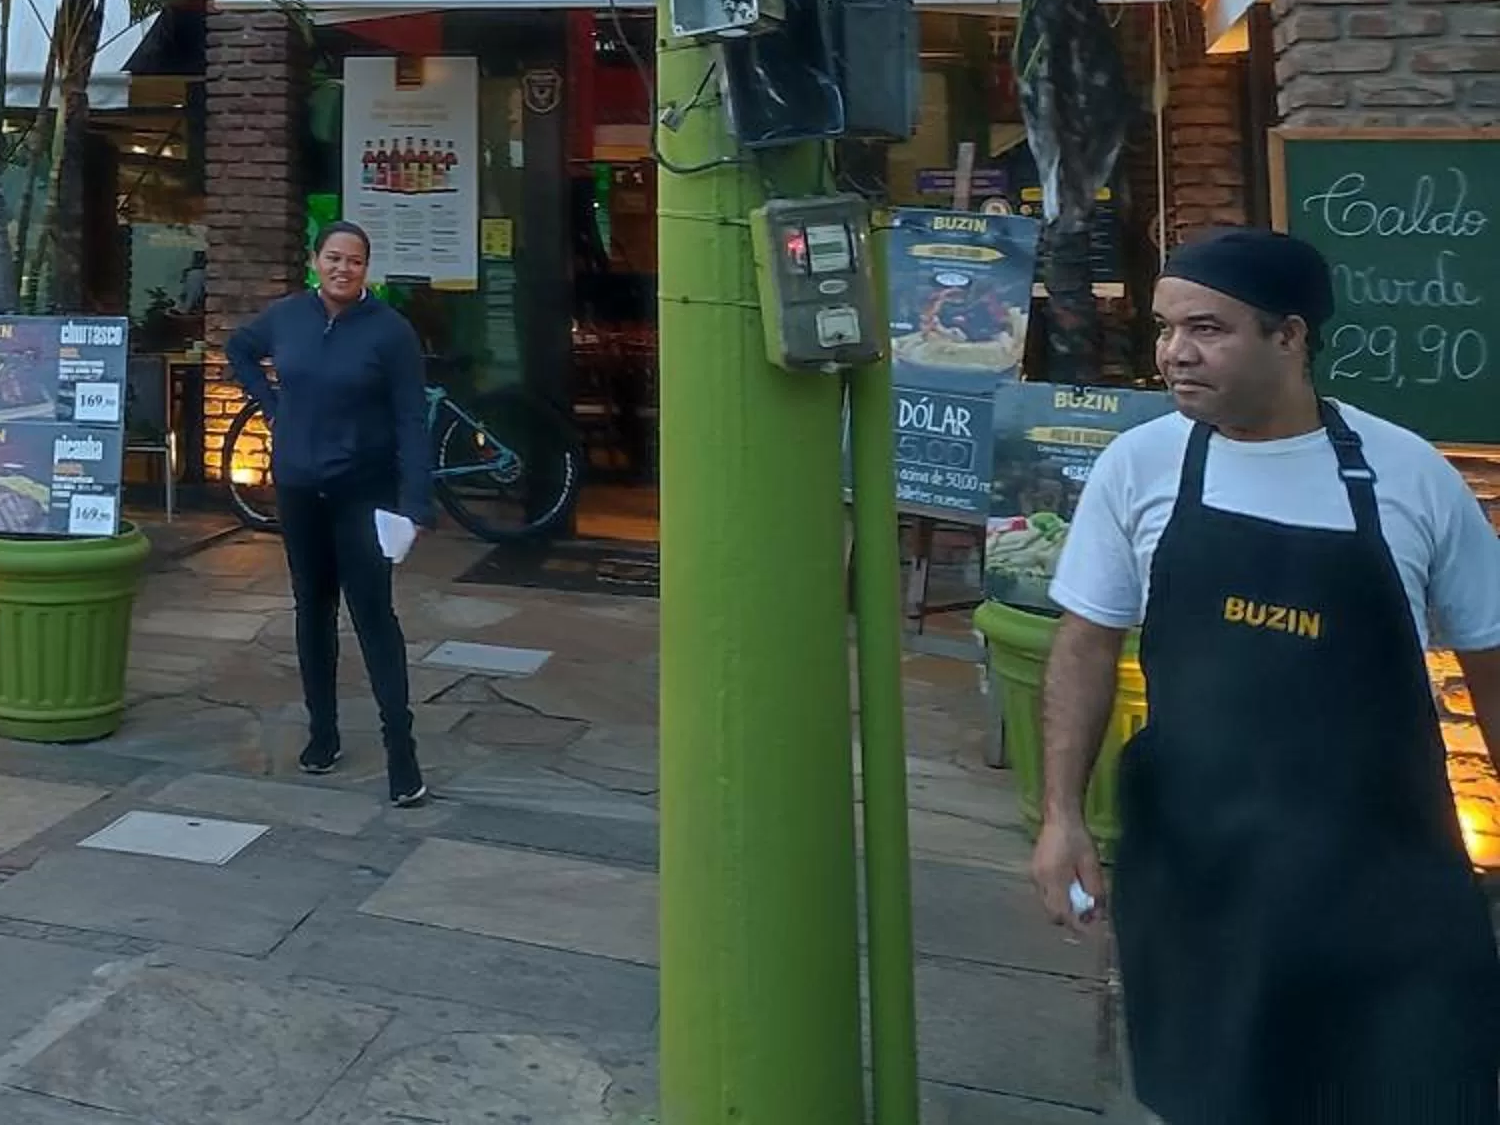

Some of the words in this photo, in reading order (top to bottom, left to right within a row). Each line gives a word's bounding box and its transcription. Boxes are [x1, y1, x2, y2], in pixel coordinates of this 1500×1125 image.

[1303, 167, 1489, 236] Caldo
[932, 216, 987, 233] BUZIN
[60, 321, 122, 346] churrasco
[1329, 324, 1487, 387] 29,90
[898, 396, 972, 437] DÓLAR
[1053, 391, 1120, 413] BUZIN
[53, 434, 103, 466] picanha
[1224, 596, 1321, 640] BUZIN
